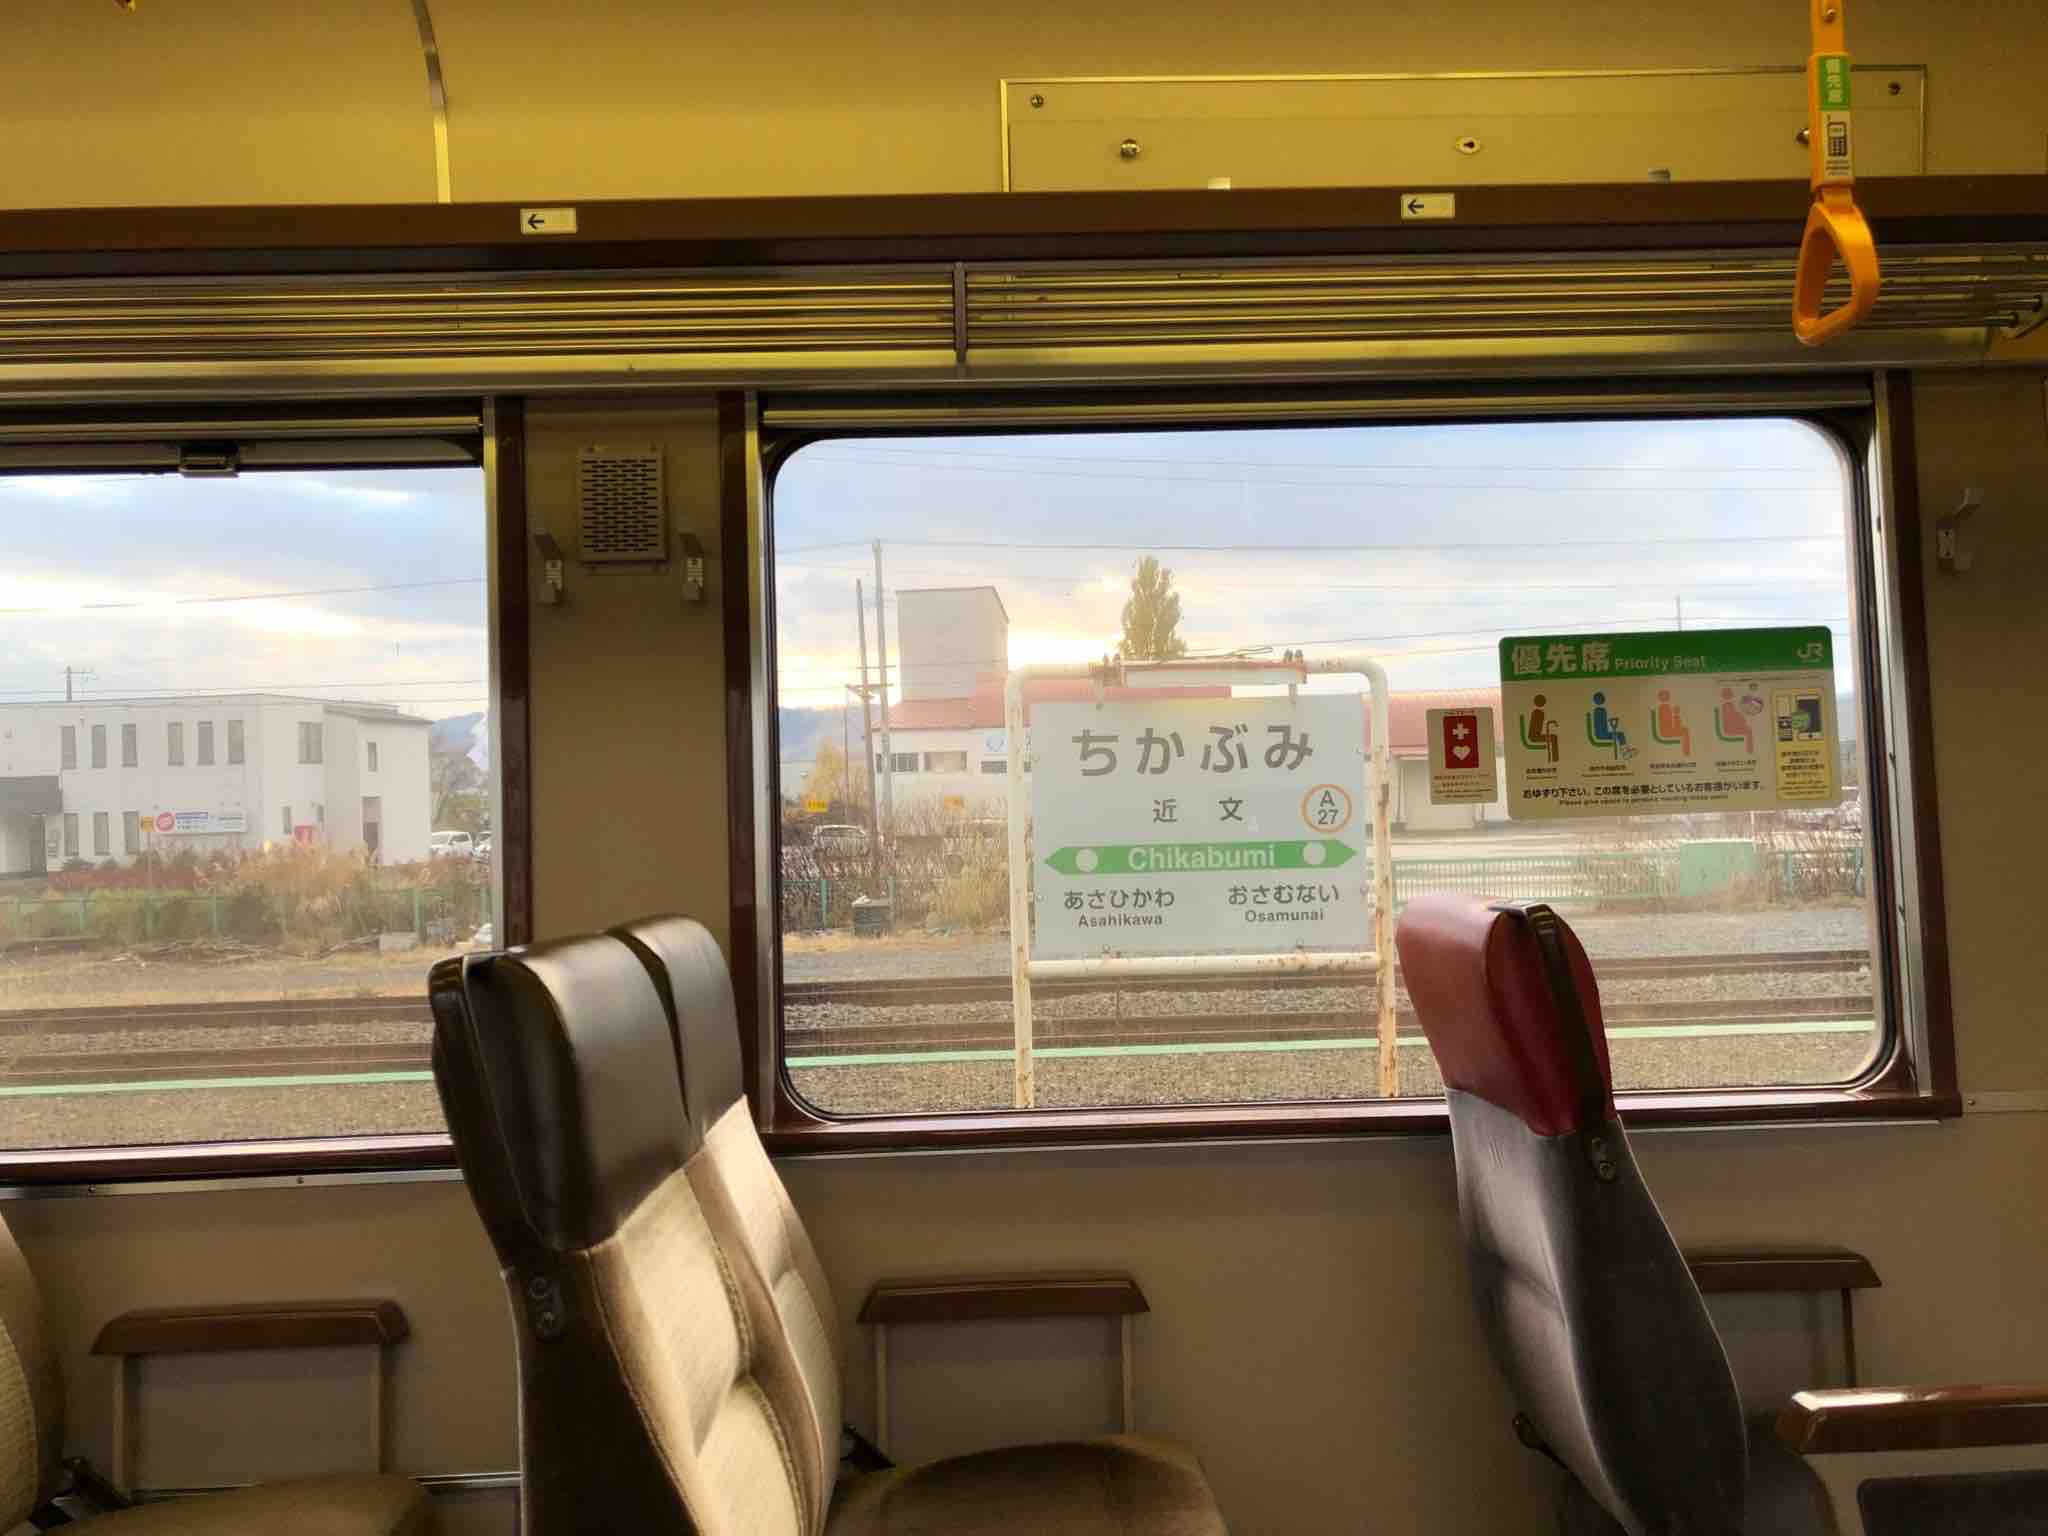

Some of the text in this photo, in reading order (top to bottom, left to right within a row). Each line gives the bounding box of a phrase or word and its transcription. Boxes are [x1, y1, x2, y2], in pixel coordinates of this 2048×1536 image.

[1511, 641, 1611, 675] 優先席
[1797, 642, 1824, 659] JR
[1615, 655, 1705, 671] Priority Seat
[1072, 724, 1313, 776] ちかぶみ
[1319, 790, 1336, 807] A
[1317, 808, 1339, 825] 27
[1128, 844, 1275, 871] Chikabumi
[1063, 888, 1175, 910] あさひかわ
[1227, 884, 1340, 905] おさむない
[1078, 913, 1163, 928] Asahikawa
[1244, 908, 1324, 923] Osamunai
